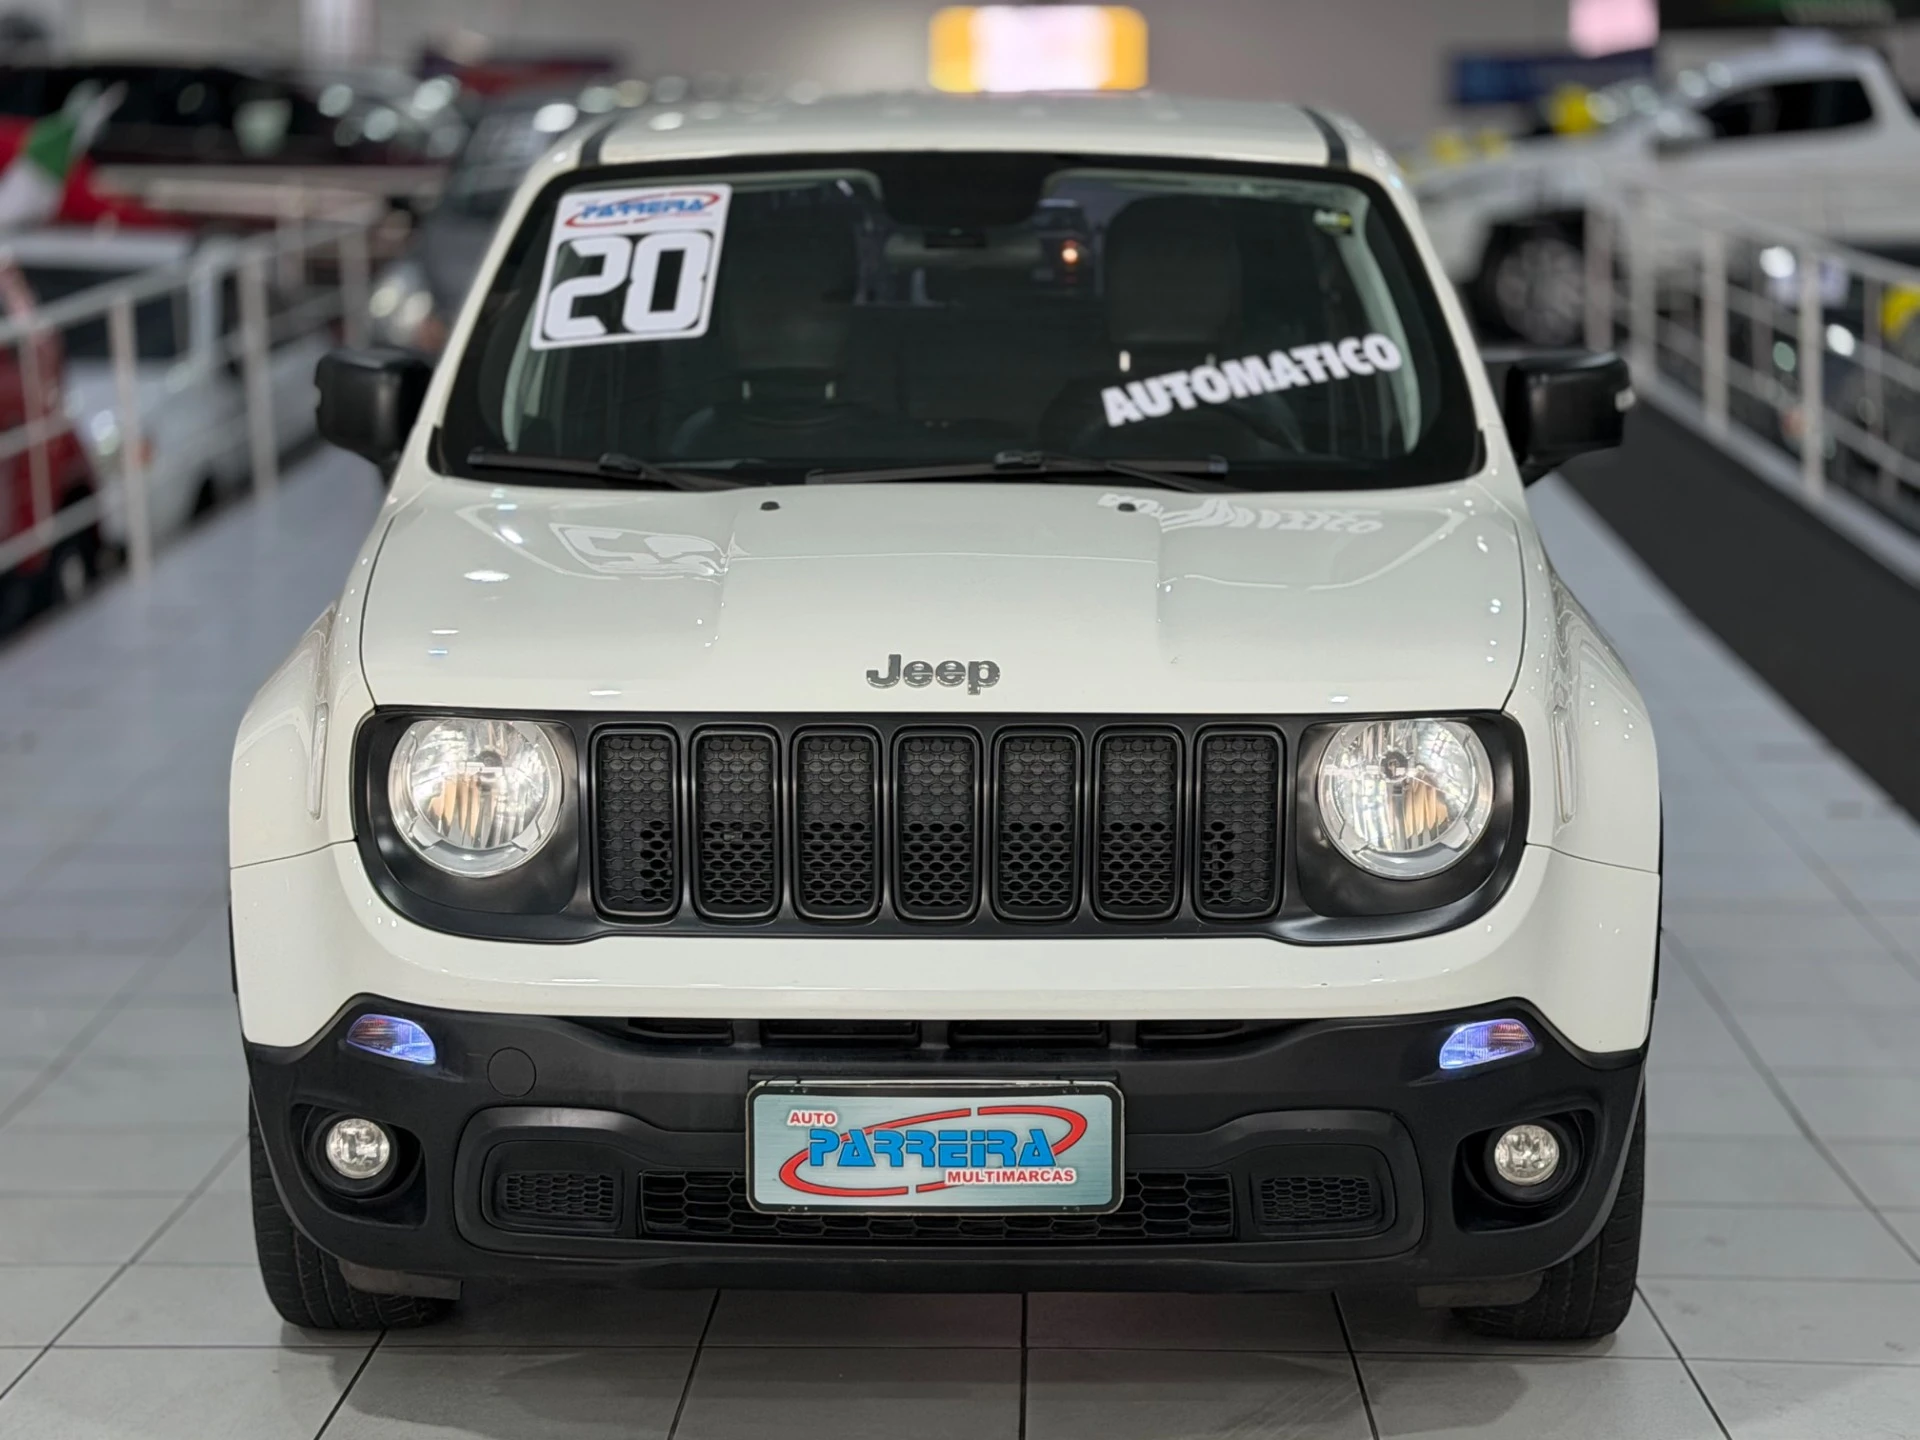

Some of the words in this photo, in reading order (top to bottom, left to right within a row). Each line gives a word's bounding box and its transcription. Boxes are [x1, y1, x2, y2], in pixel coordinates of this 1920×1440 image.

[543, 231, 713, 341] 20
[1100, 333, 1402, 428] AUTOMATICO
[866, 654, 1000, 695] Jeep
[789, 1111, 837, 1126] AUTO
[808, 1128, 1057, 1168] PARREIRA
[947, 1169, 1075, 1183] MULTIMARCAS
